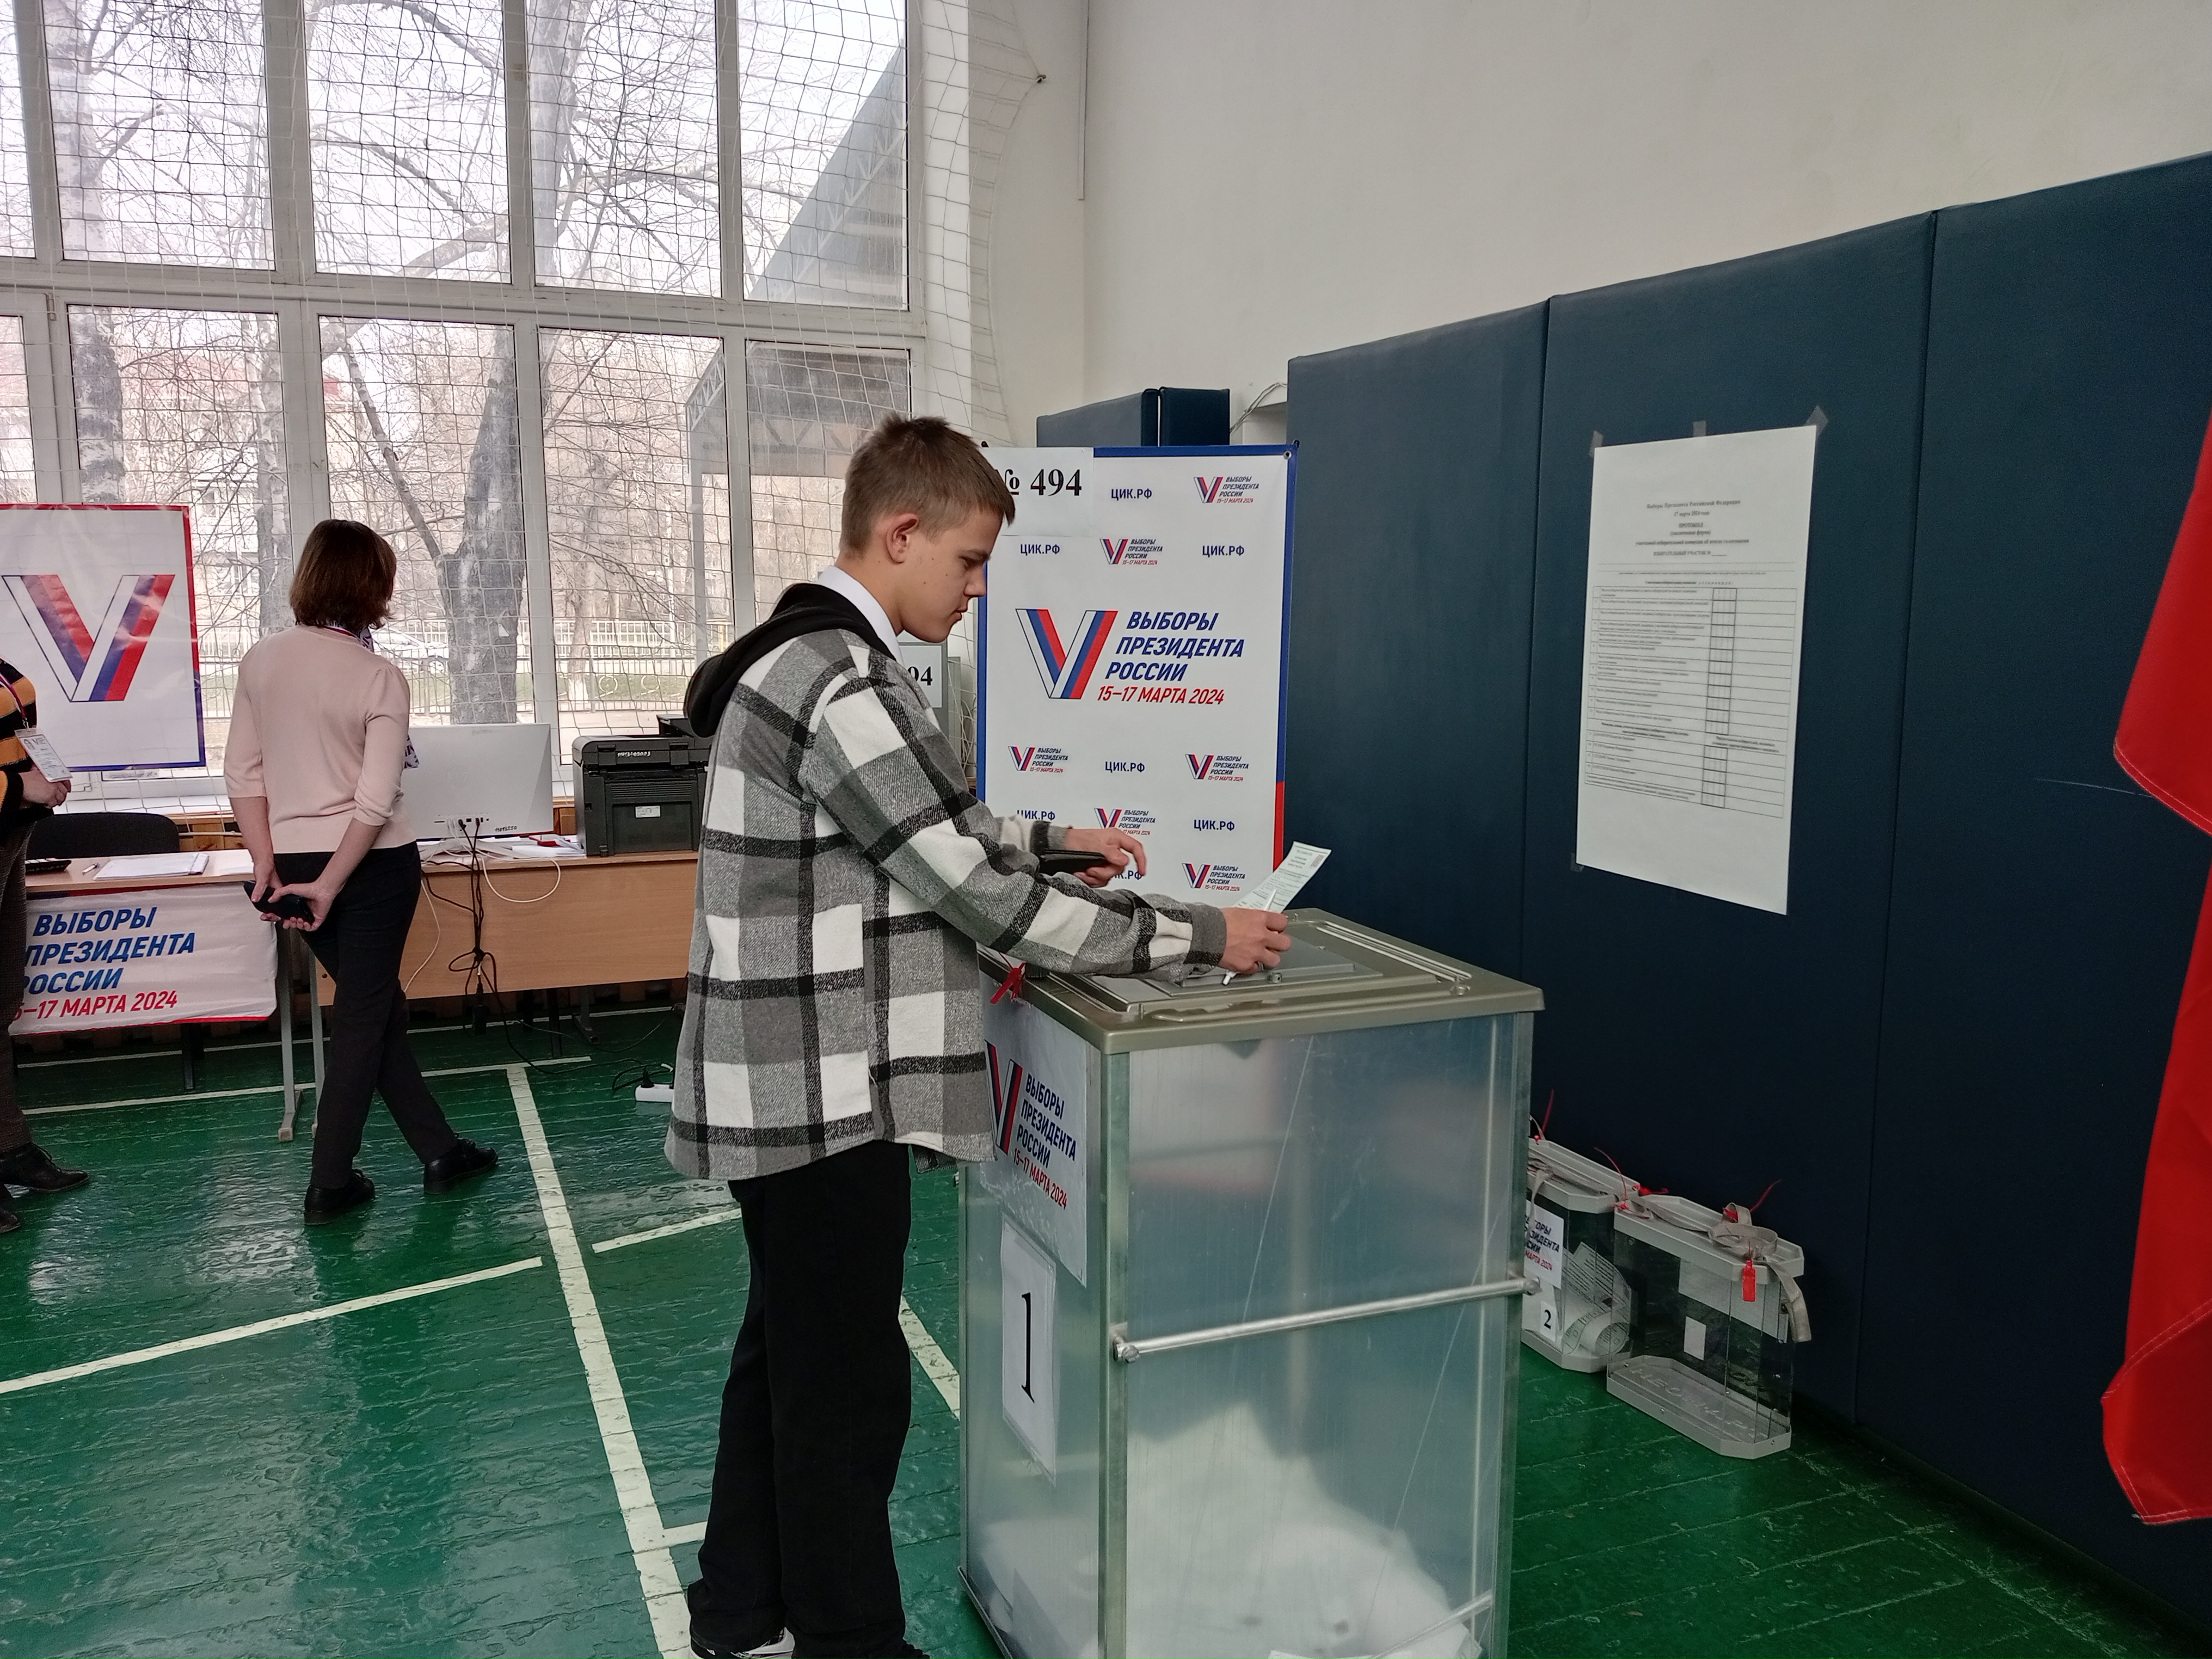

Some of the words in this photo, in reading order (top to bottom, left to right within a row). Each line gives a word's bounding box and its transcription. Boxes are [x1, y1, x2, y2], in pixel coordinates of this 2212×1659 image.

[1030, 469, 1082, 496] 494
[1111, 488, 1152, 501] ЦИК.РФ
[1020, 544, 1060, 555] ЦИК.РФ
[1202, 545, 1244, 556] ЦИК.РФ
[1126, 611, 1219, 631] ВЫБОРЫ
[1115, 637, 1244, 659] ПРЕЗИДЕНТА
[1105, 662, 1188, 681] РОССИИ
[1138, 687, 1187, 703] МАРТА
[1189, 689, 1224, 704] 2024
[1105, 761, 1145, 773] ЦИК.РФ
[1194, 819, 1234, 831] ЦИК.РФ
[32, 907, 157, 936] ВЫБОРЫ
[26, 932, 195, 967] ПРЕЗИДЕНТА
[59, 994, 127, 1017] МАРТА
[131, 990, 177, 1011] 2024
[1025, 1073, 1064, 1120] ВЫБОРЫ
[1021, 1099, 1076, 1161] ПРЕЗИДЕНТА
[1017, 1124, 1050, 1169] РОССИИ
[1029, 1165, 1050, 1196] МАРТА
[1050, 1183, 1067, 1210] 2024
[1544, 1309, 1552, 1329] 2
[1022, 1292, 1034, 1403] 1
